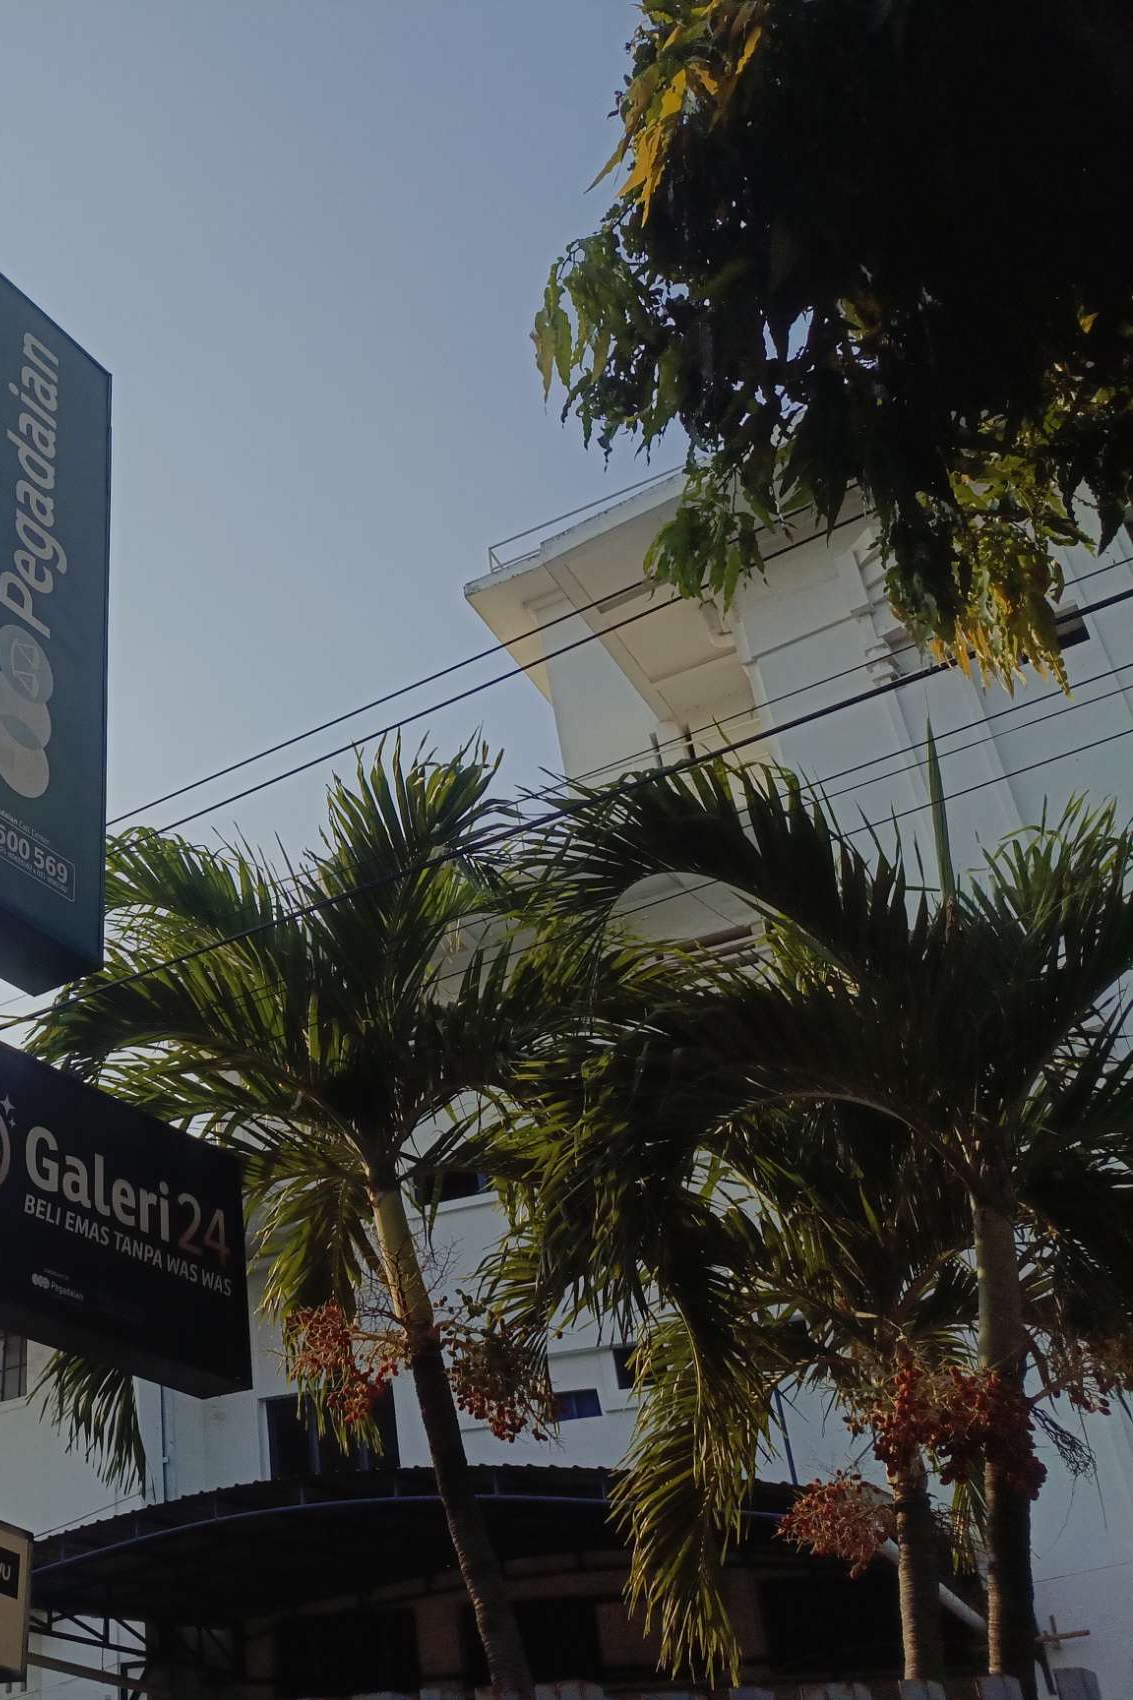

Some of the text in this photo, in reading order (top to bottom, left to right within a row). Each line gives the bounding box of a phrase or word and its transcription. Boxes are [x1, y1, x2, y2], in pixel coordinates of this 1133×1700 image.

[33, 846, 68, 884] 569
[24, 1194, 232, 1297] BELI EMAS TANPA WAS WAS
